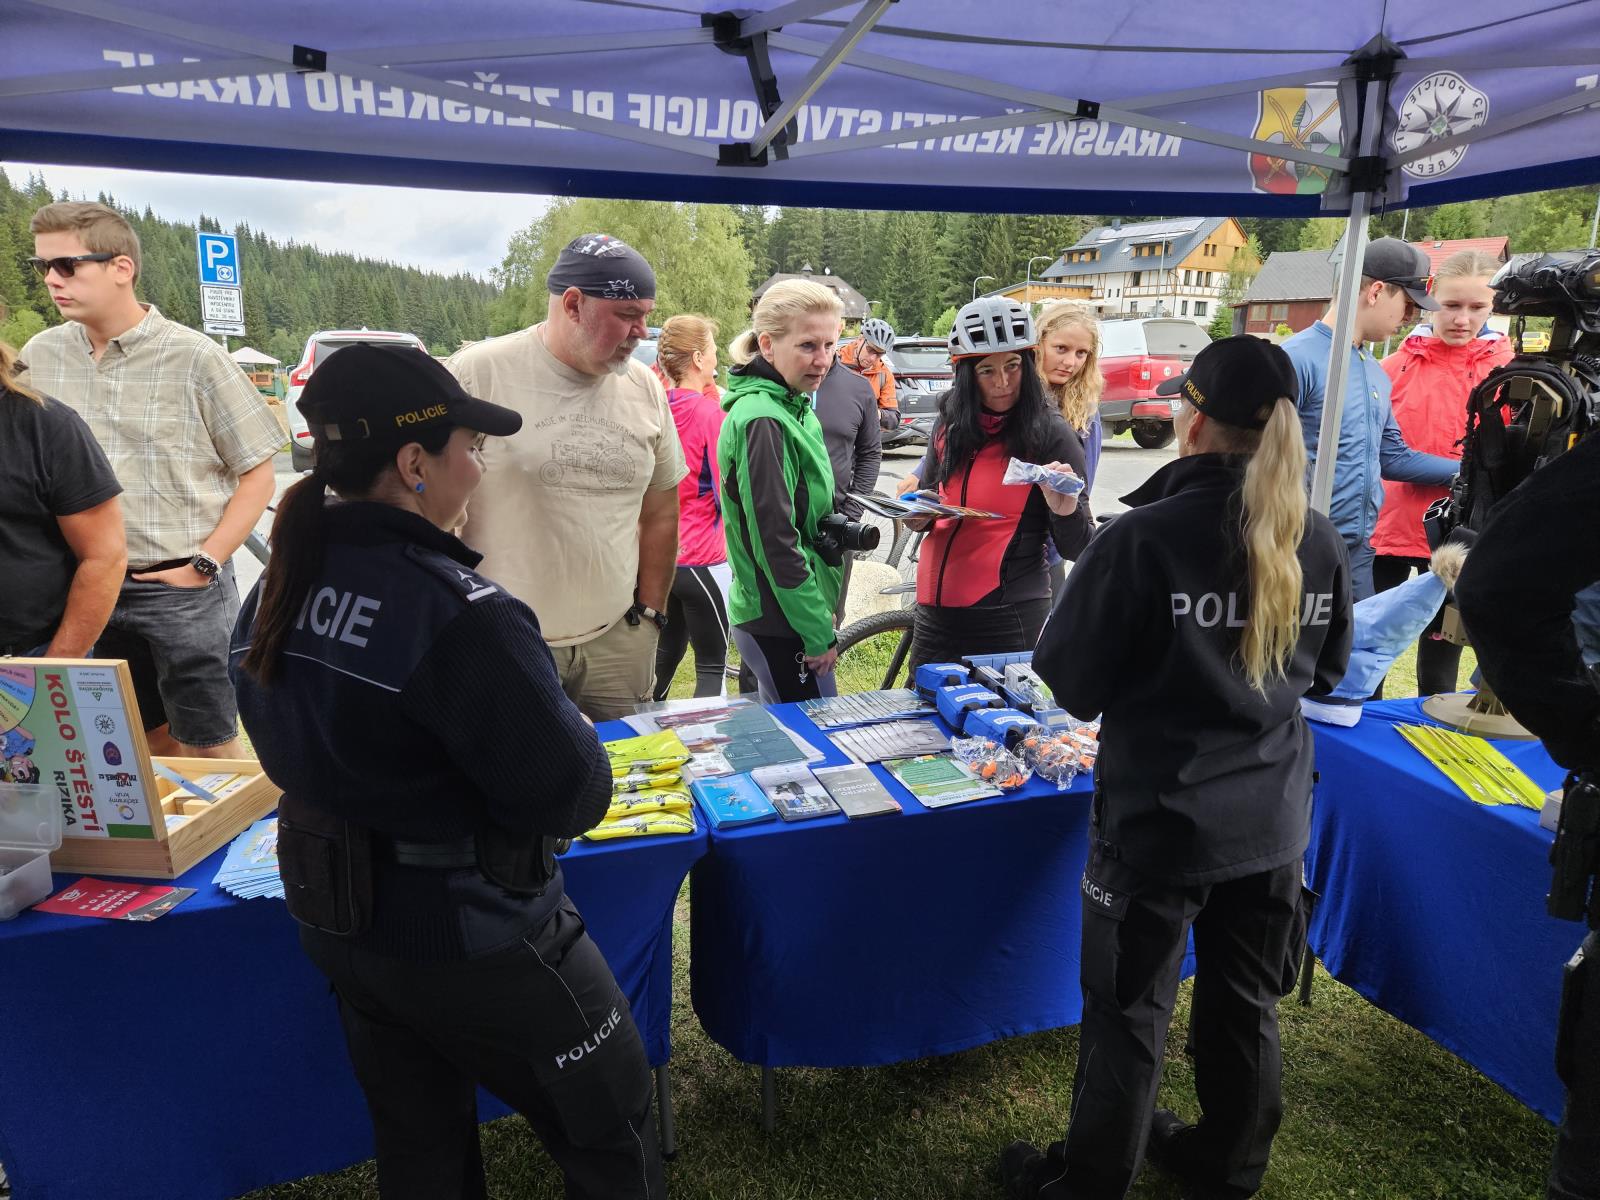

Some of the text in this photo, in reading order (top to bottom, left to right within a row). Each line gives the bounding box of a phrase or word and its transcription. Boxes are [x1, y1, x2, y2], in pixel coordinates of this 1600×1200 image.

[206, 239, 229, 269] P
[1184, 380, 1206, 405] POLICIE
[395, 403, 448, 428] POLICIE
[535, 415, 556, 431] MADE
[1170, 592, 1334, 629] POLIE
[44, 673, 104, 832] KOLO ŠTĚSTÍ
[53, 770, 77, 826] RIZIKA
[555, 1007, 621, 1069] POLICIE
